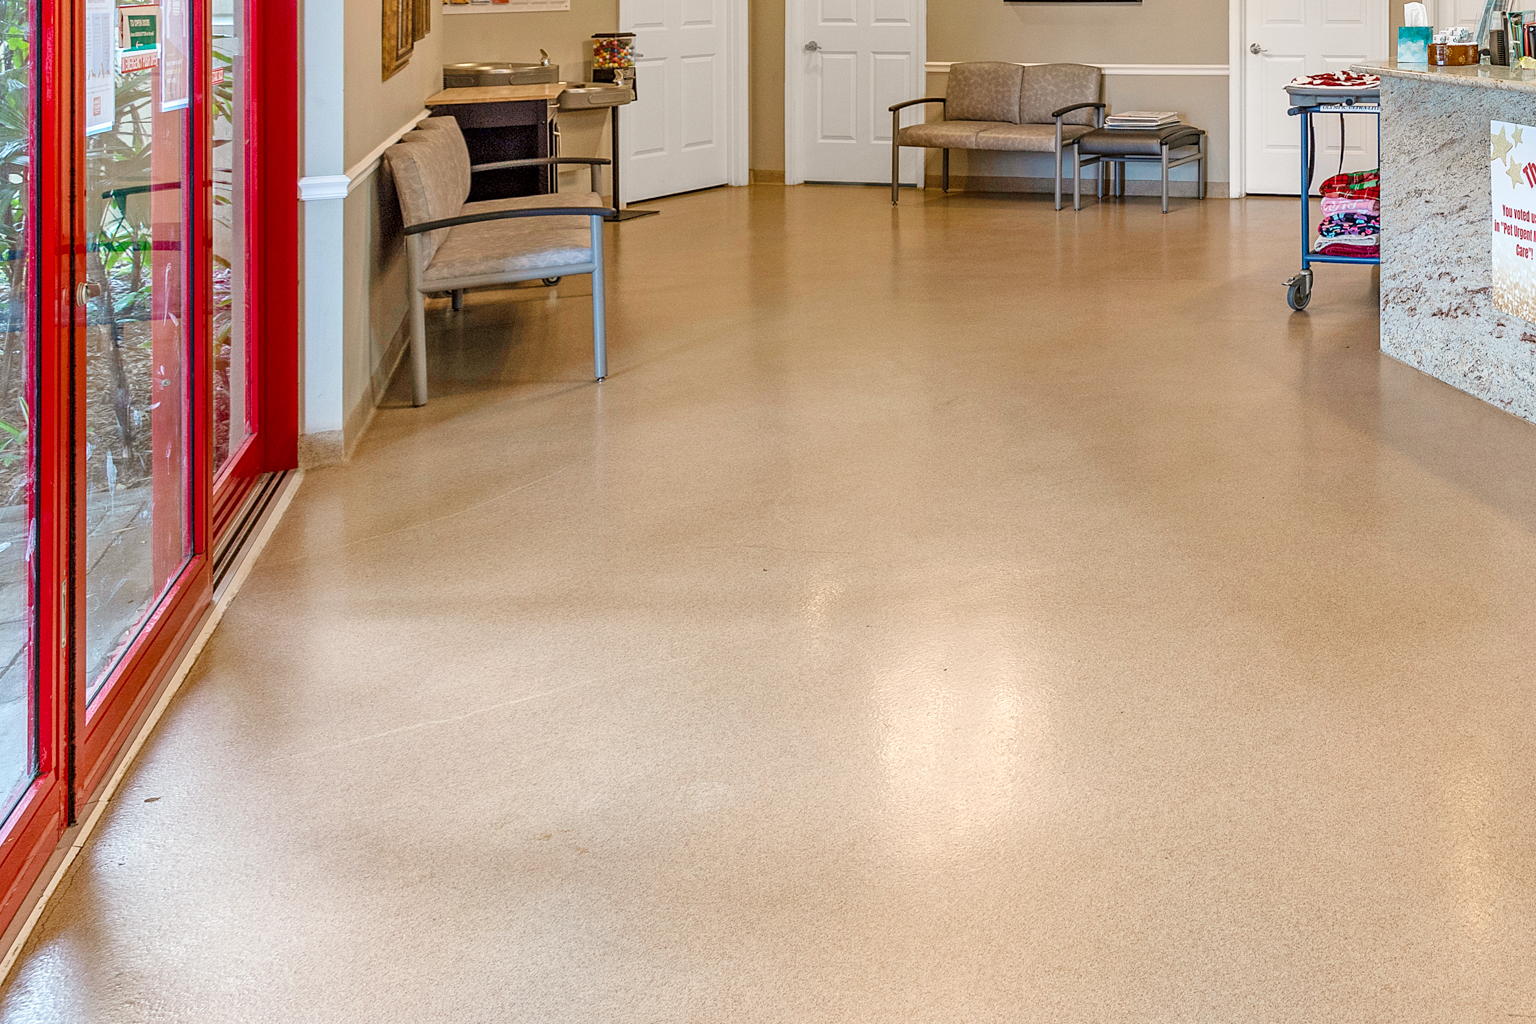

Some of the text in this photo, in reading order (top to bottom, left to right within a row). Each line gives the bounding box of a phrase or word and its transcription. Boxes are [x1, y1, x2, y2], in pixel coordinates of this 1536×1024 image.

[1502, 204, 1512, 218] You
[1514, 208, 1530, 222] voted
[1494, 219, 1500, 232] in
[1514, 225, 1532, 241] Urgent
